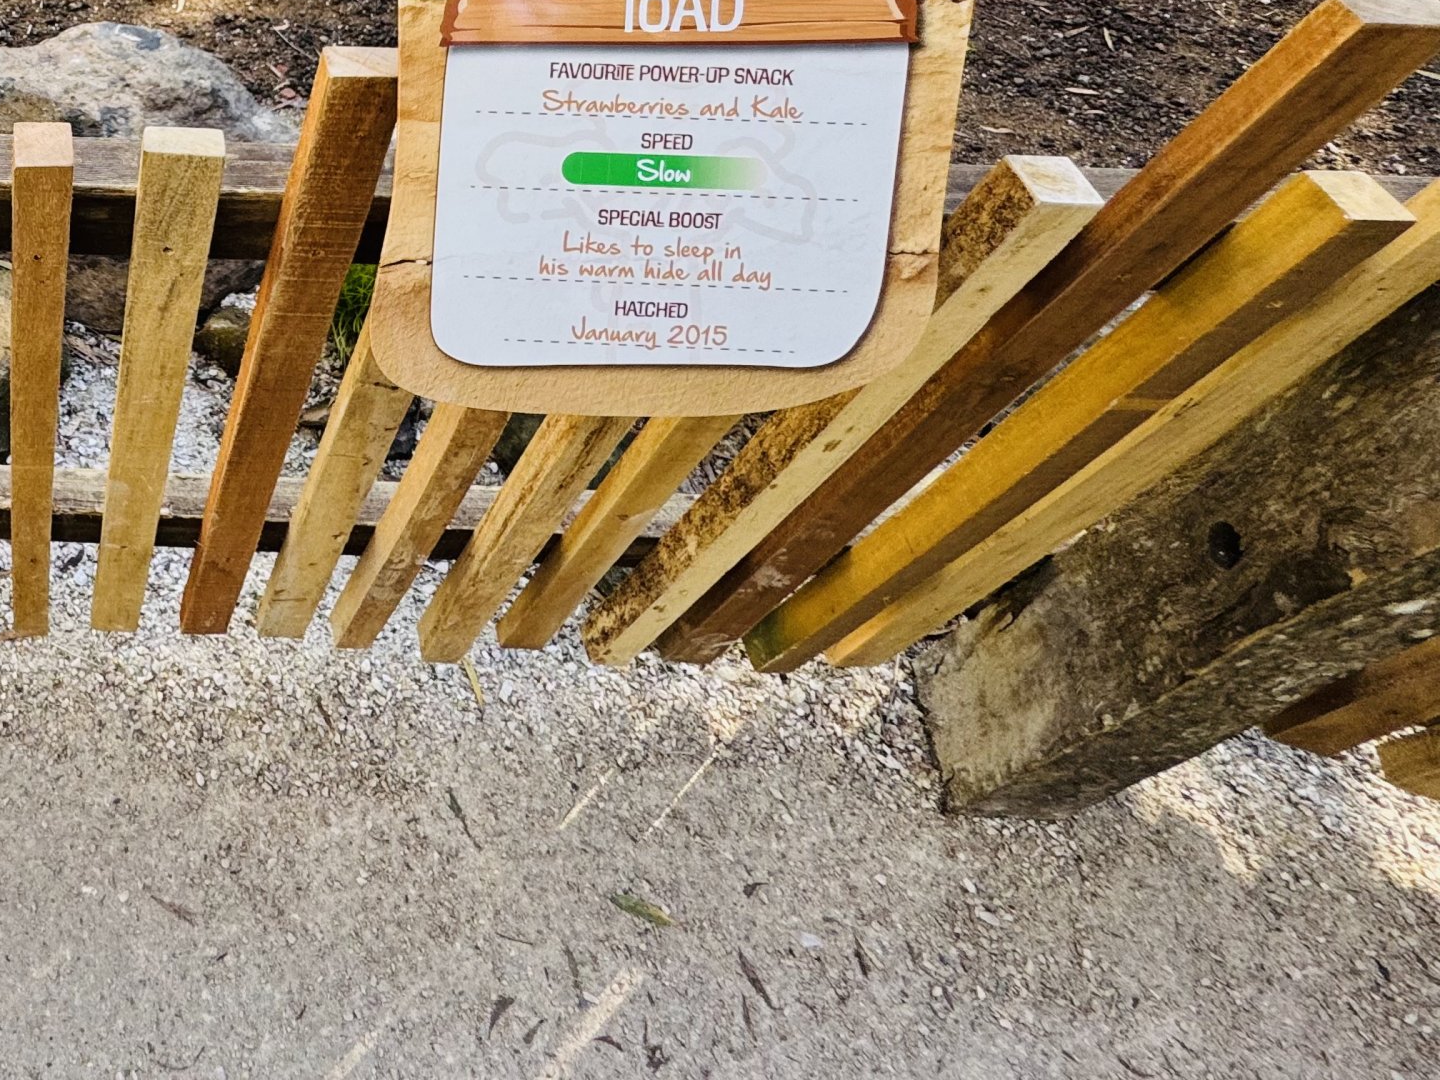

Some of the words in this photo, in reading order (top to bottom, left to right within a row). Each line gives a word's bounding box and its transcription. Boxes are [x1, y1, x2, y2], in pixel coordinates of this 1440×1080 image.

[639, 65, 730, 83] POWER-UP
[734, 68, 794, 86] SNACK
[542, 90, 690, 117] Strawberries
[699, 100, 739, 118] and
[750, 95, 804, 120] Kale
[641, 133, 693, 150] SPEED
[637, 159, 691, 183] Slow
[668, 212, 723, 230] BOOST
[563, 231, 621, 255] Likes
[631, 238, 653, 257] to
[663, 237, 714, 266] sleep
[725, 241, 742, 260] in
[539, 255, 569, 277] his
[578, 264, 635, 279] warm
[644, 261, 690, 280] hide
[697, 261, 723, 282] all
[732, 264, 772, 291] day
[614, 301, 688, 319] HATCHED
[571, 316, 657, 349] January
[667, 325, 727, 346] 2015
